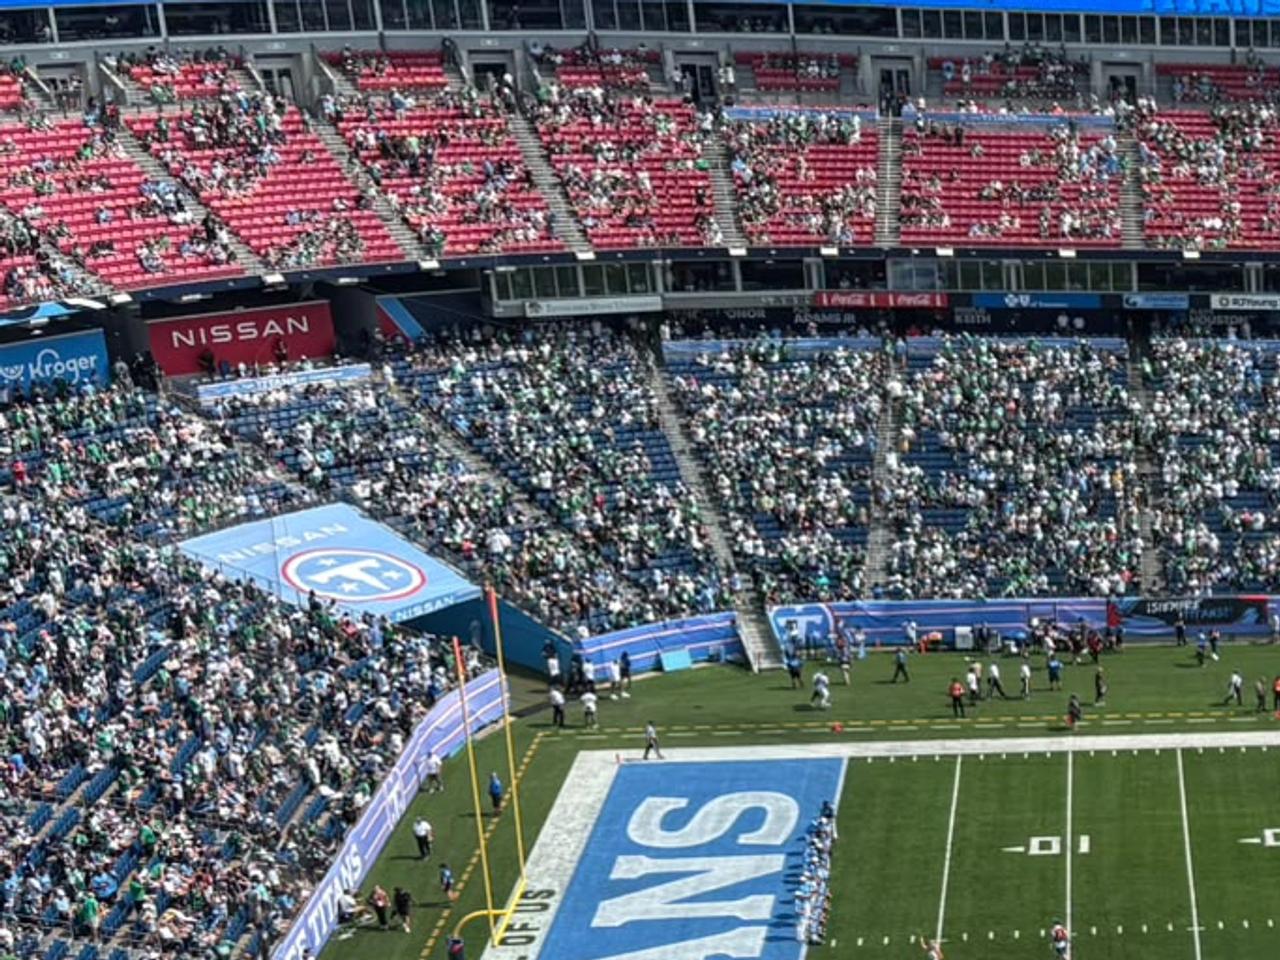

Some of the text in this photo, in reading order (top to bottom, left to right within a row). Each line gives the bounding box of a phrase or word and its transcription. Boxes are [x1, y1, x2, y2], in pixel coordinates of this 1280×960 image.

[172, 315, 310, 348] NISSAN
[29, 349, 98, 380] Kroger
[218, 522, 349, 565] NISSAN
[305, 844, 364, 955] TITANS
[515, 888, 557, 913] US
[498, 921, 540, 946] OF
